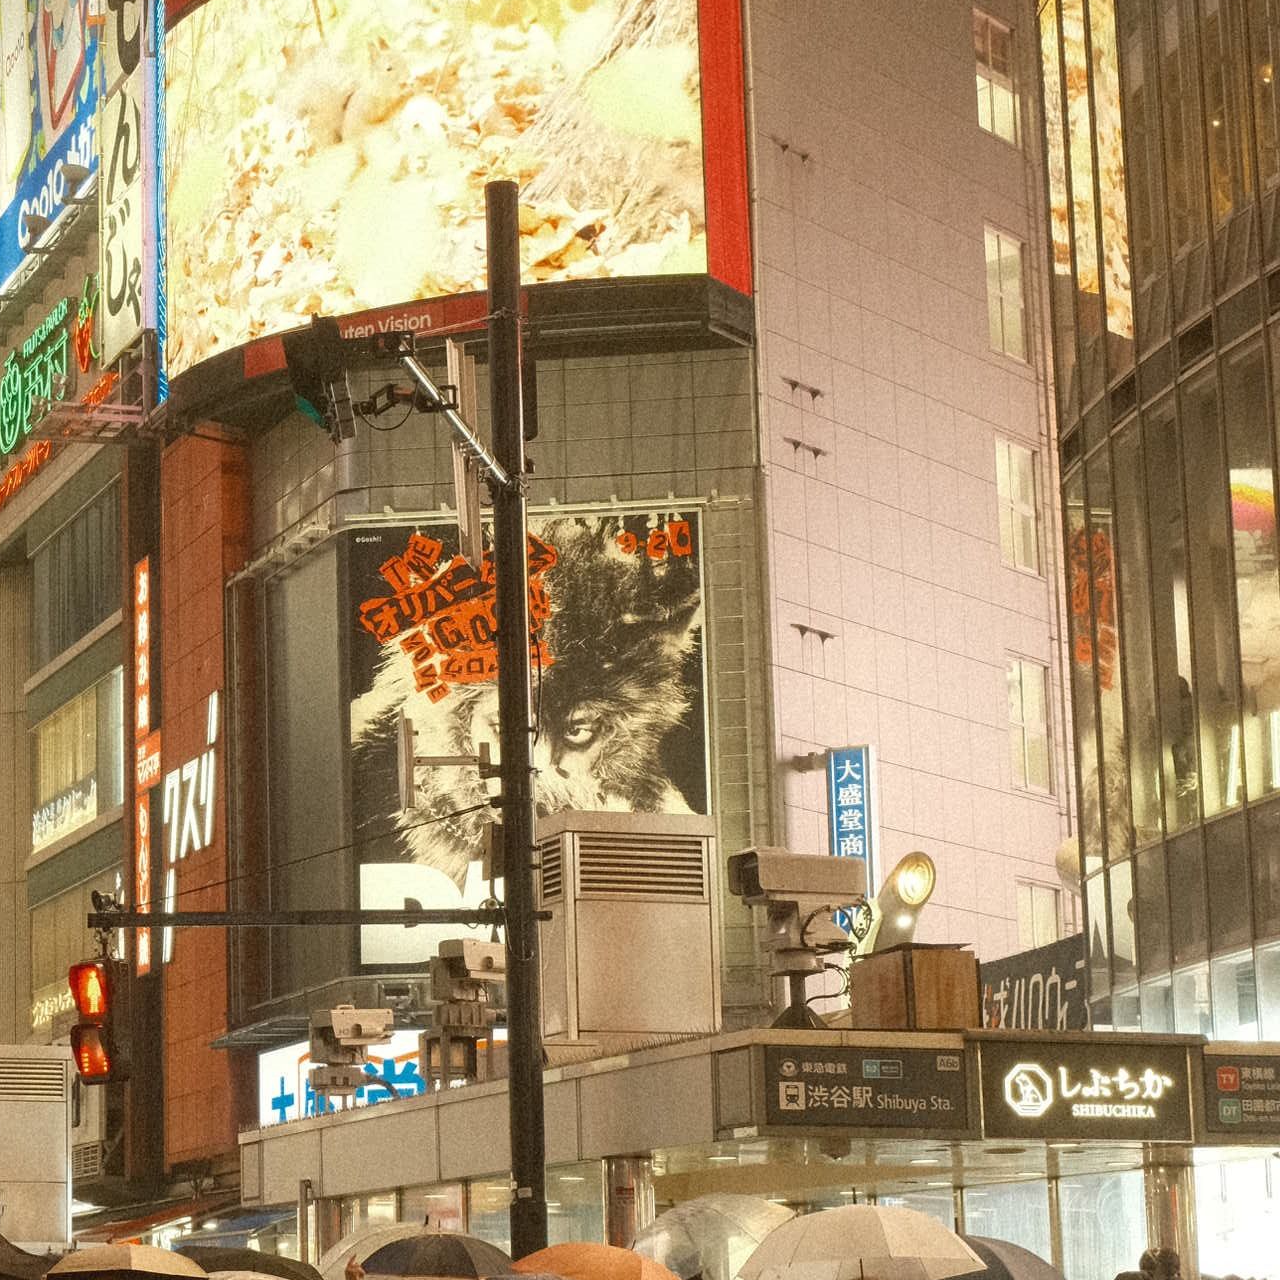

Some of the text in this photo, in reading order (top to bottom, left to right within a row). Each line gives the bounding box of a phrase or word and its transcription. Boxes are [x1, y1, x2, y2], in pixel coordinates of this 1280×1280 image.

[1057, 1066, 1173, 1100] しぶちか
[1220, 1073, 1235, 1085] TY
[807, 1085, 955, 1114] 渋谷駅 Shibuya Sta.
[1072, 1103, 1156, 1119] SHIBUCHIKA
[1223, 1105, 1238, 1118] DT
